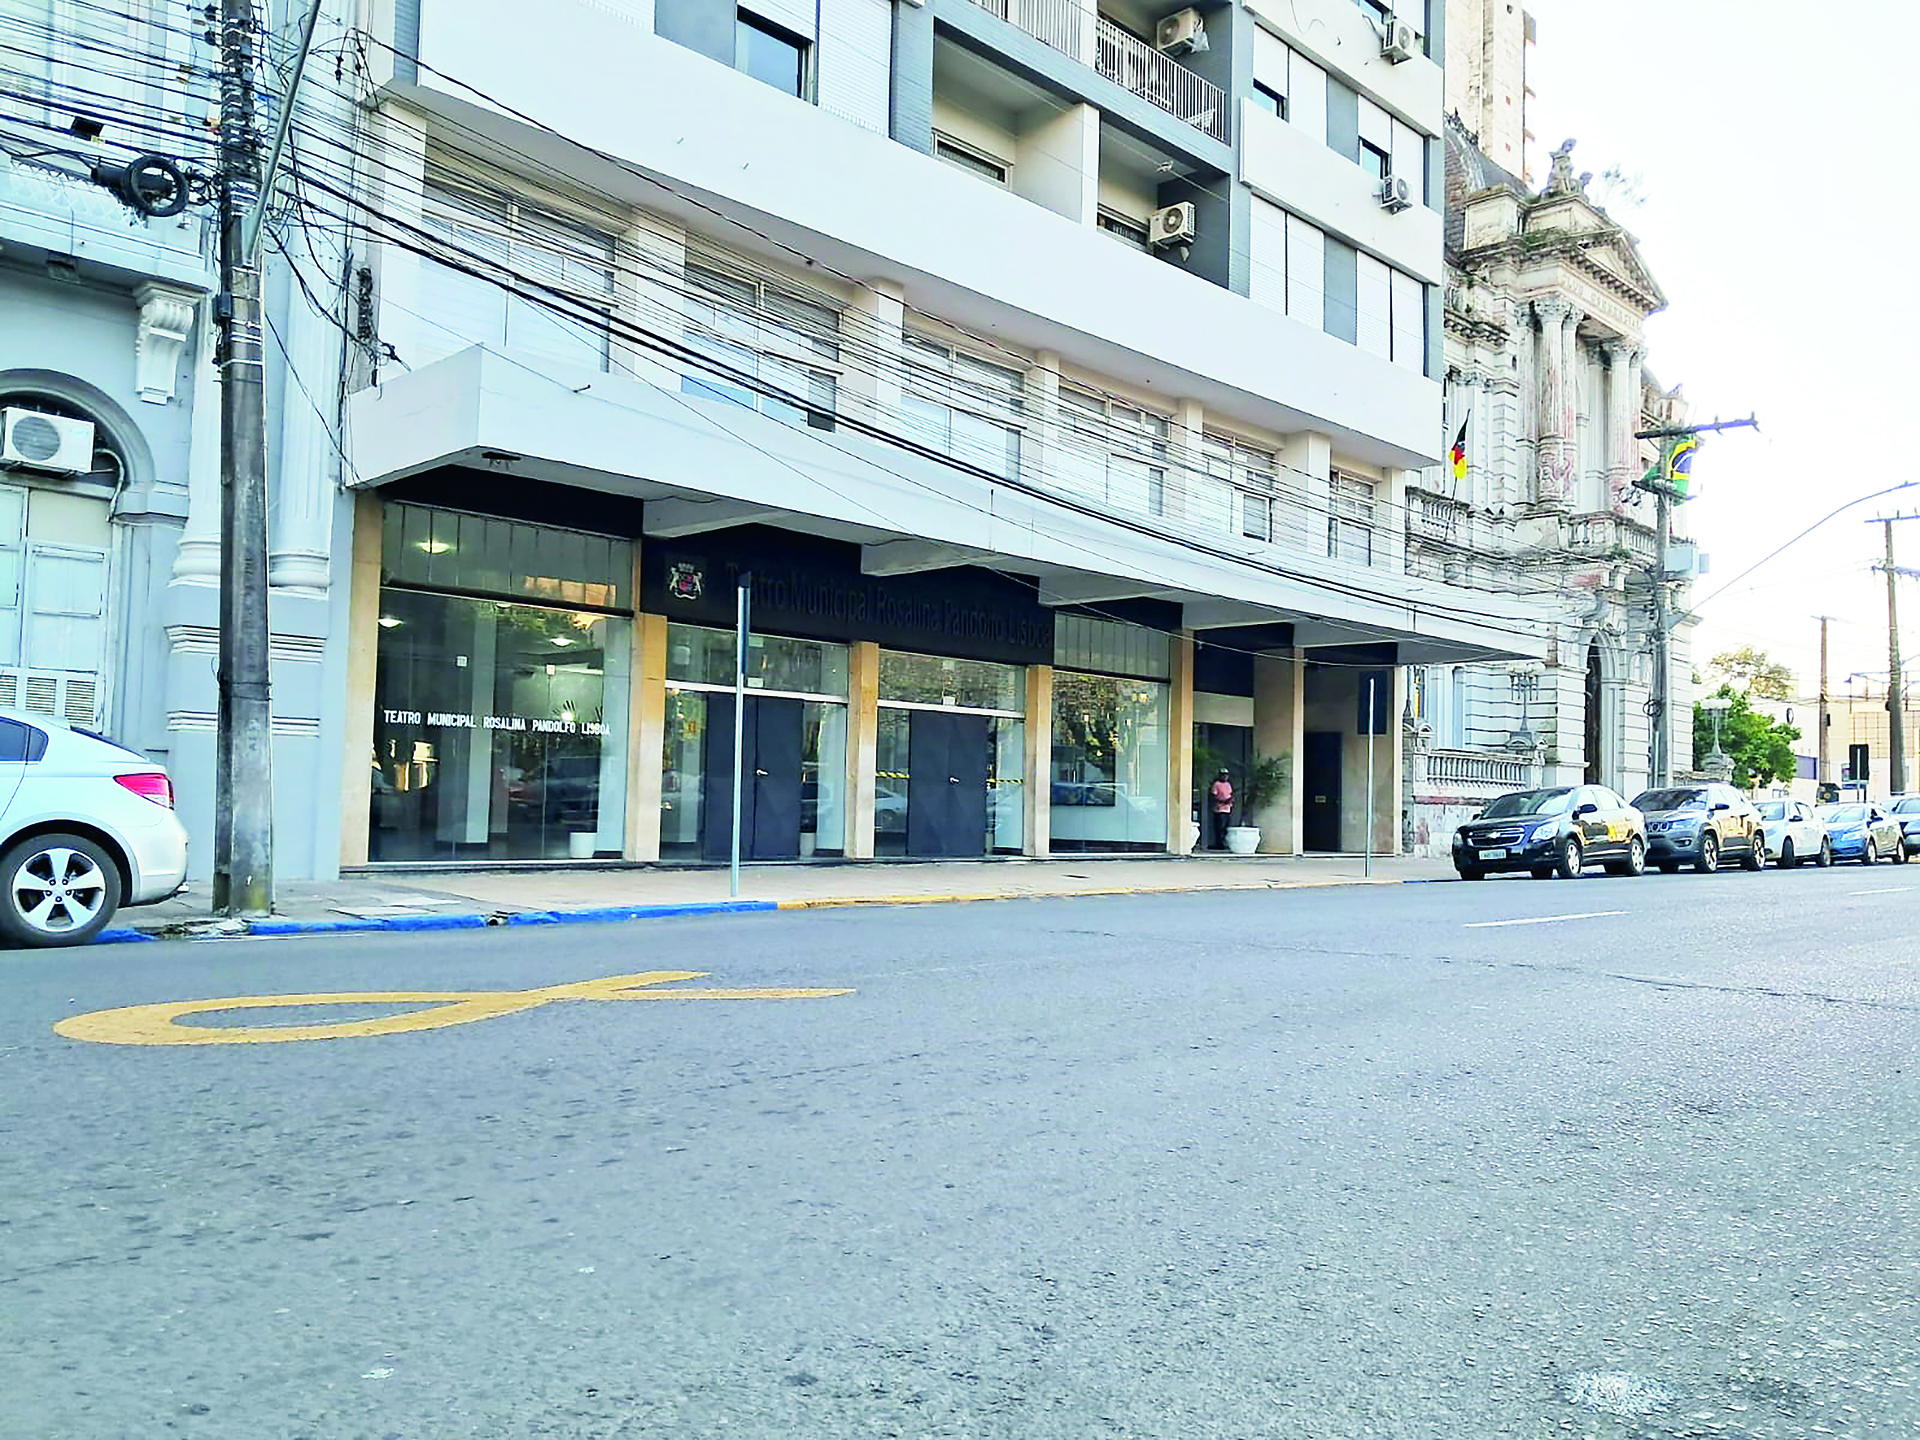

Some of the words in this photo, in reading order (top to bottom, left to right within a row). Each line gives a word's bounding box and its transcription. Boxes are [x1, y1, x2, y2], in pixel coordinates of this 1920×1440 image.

[726, 561, 786, 609] Tatro
[383, 709, 421, 725] TEATRO
[427, 712, 477, 728] MUNICIPAL
[483, 715, 526, 731] ROSALINA
[532, 719, 576, 734] PANDOLFO
[581, 723, 610, 736] LISBOA
